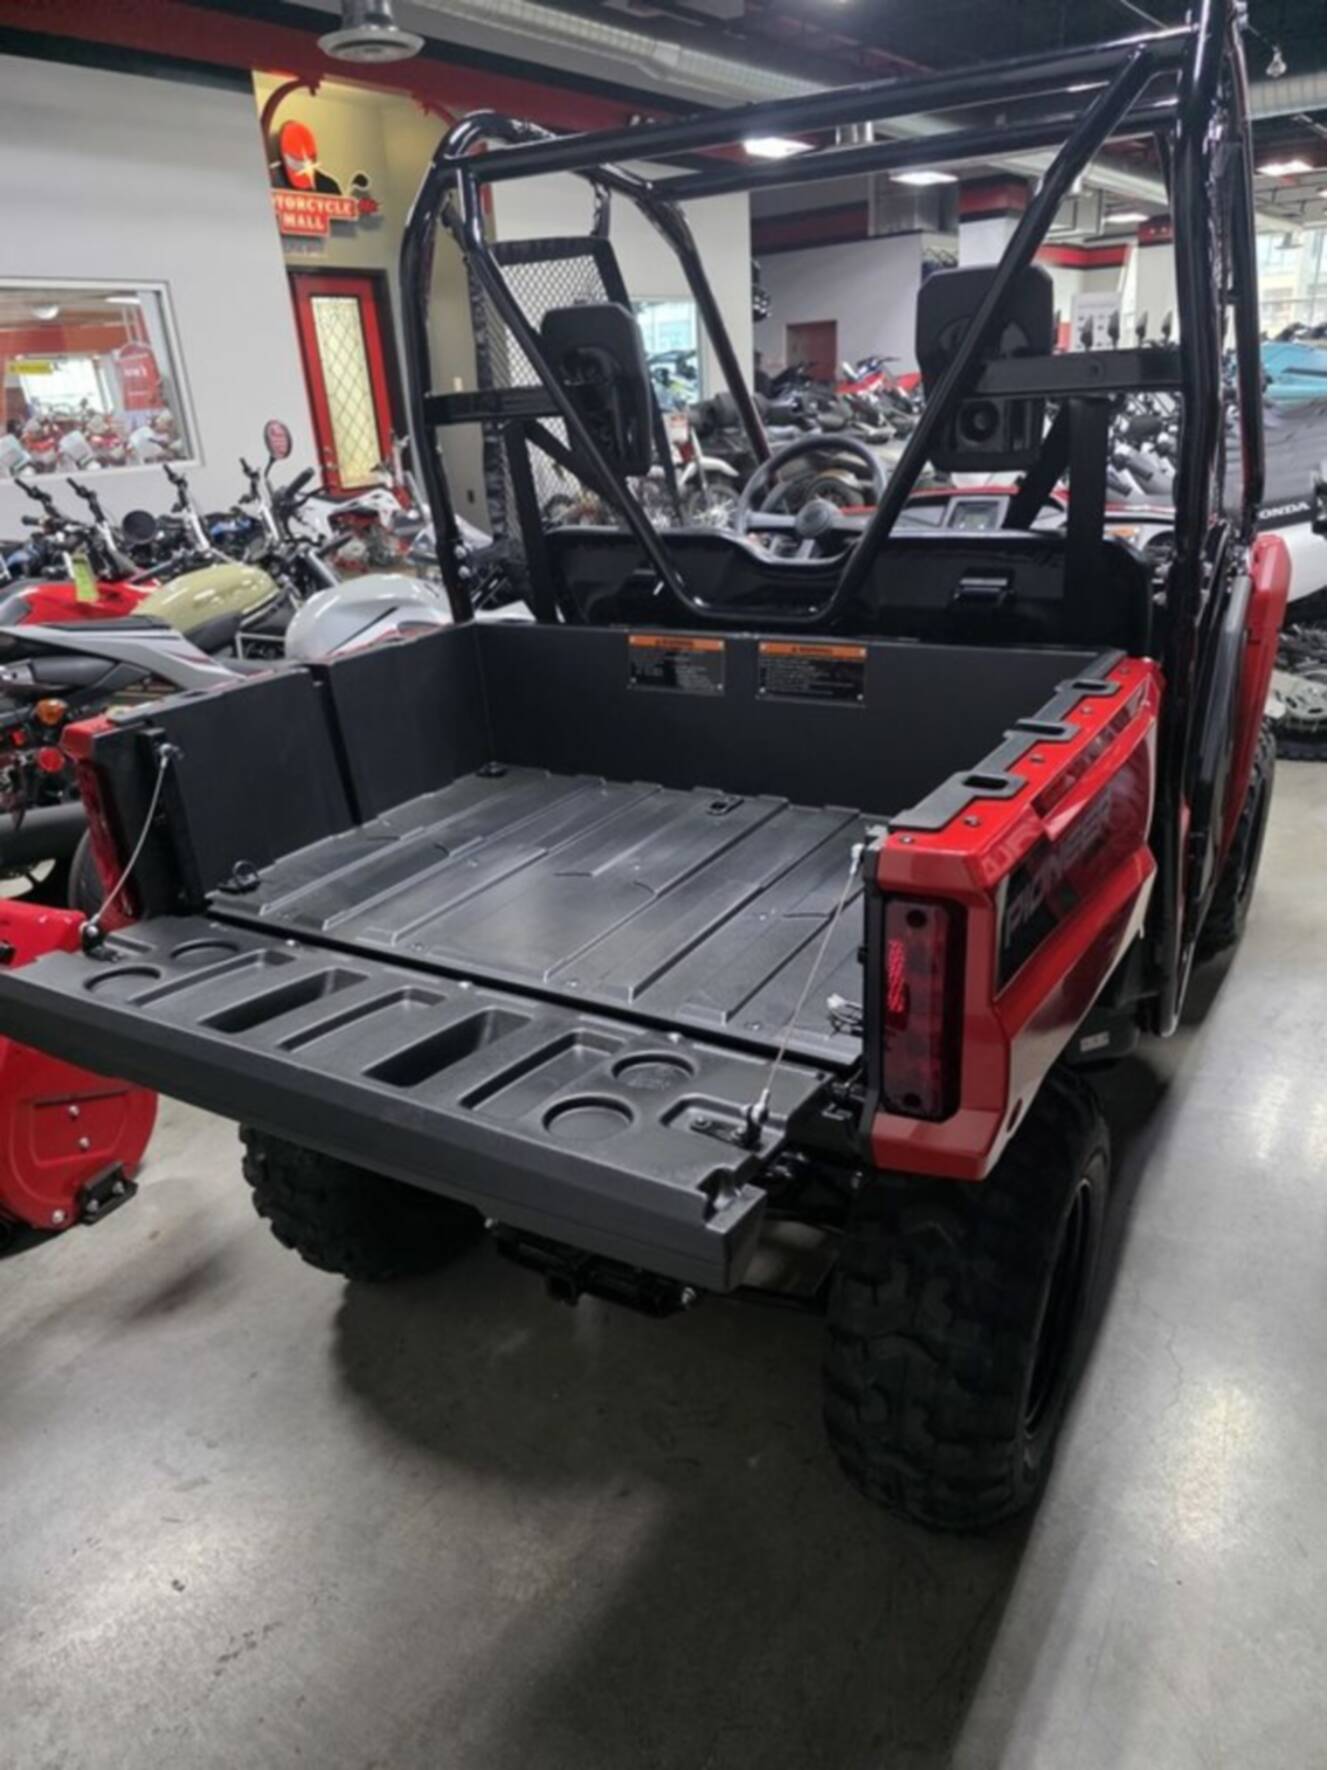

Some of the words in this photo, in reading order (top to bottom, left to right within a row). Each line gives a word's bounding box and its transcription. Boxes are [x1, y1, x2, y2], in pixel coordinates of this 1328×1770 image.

[272, 194, 353, 215] TORCYCLE
[283, 213, 325, 230] MALL
[1258, 502, 1310, 519] ONDA
